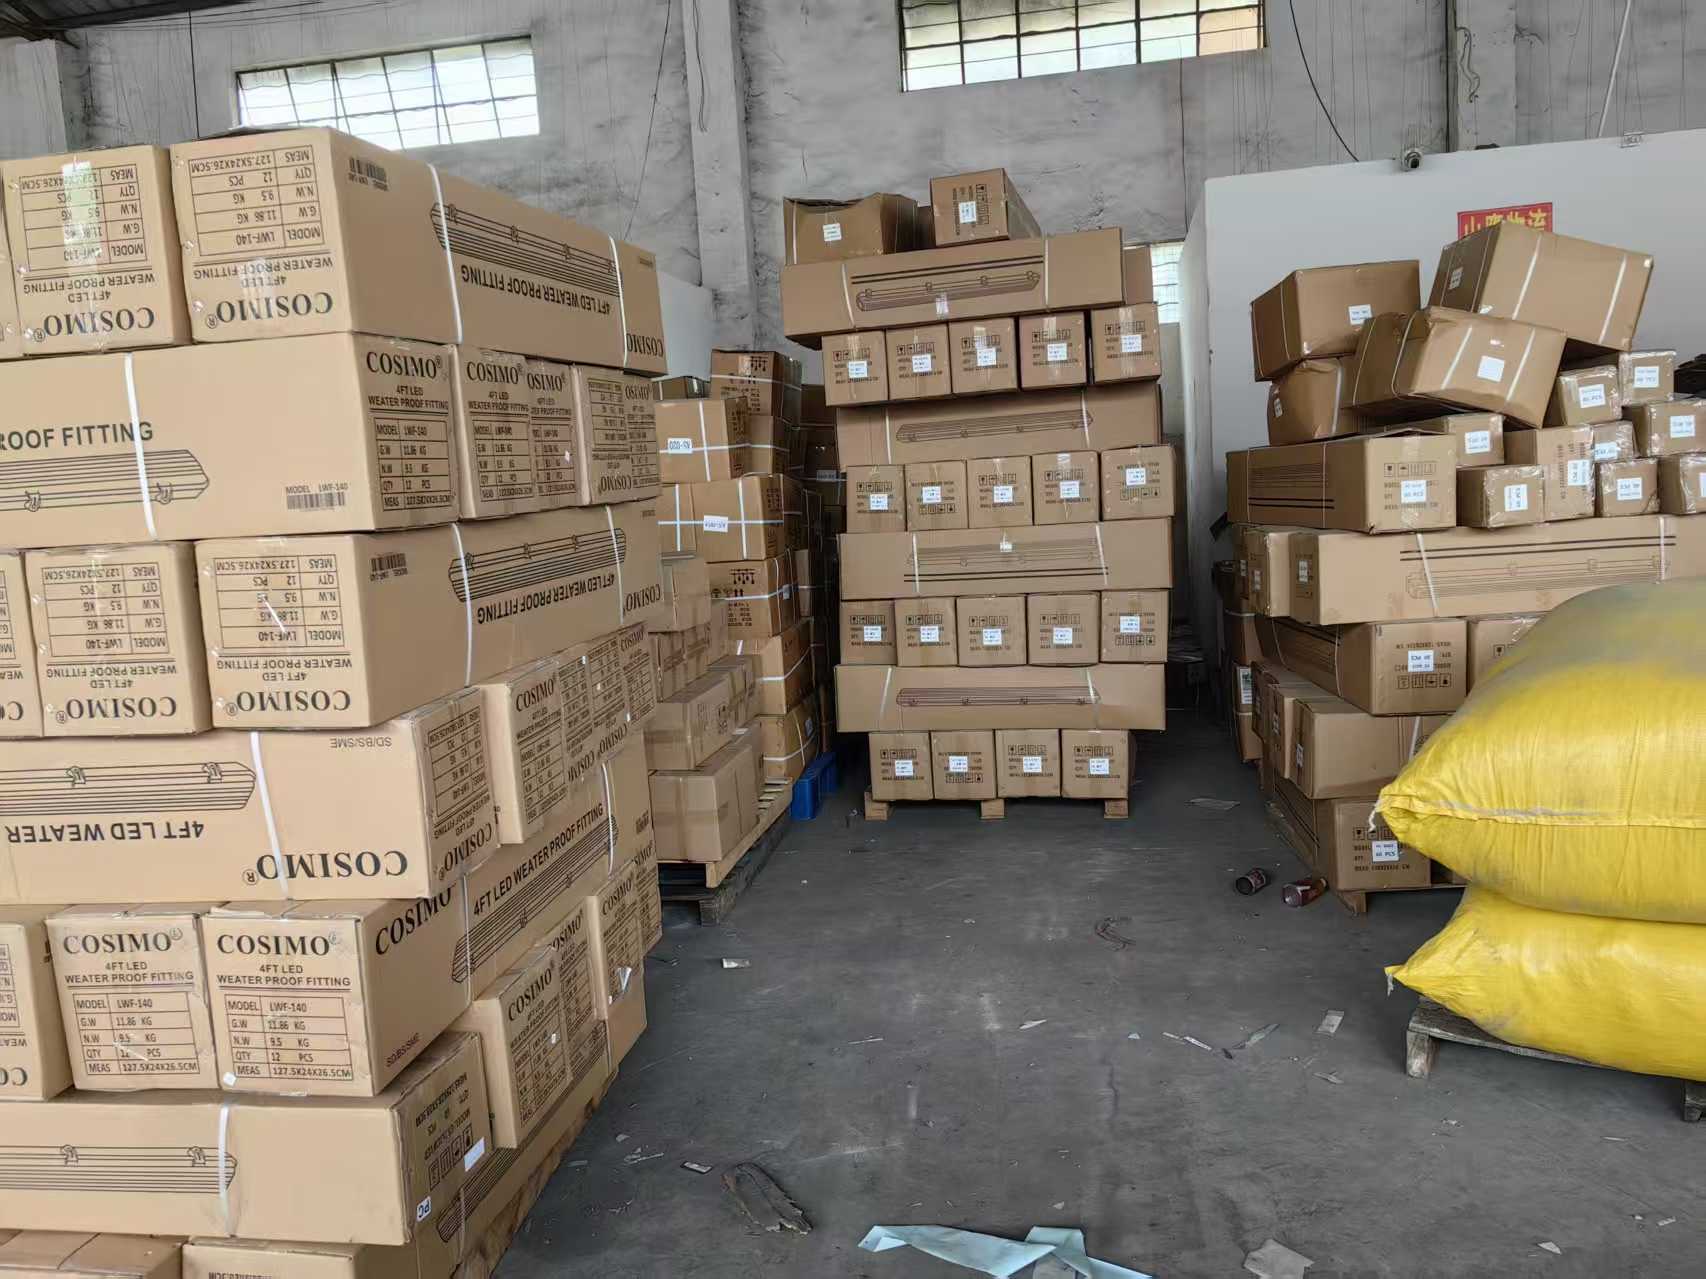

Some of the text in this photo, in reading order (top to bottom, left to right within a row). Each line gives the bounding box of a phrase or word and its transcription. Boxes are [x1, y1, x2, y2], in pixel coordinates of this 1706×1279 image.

[284, 148, 310, 161] MEAS
[109, 167, 133, 179] MEAS
[227, 166, 312, 186] QTY 12 PCS
[118, 184, 135, 196] QTY
[231, 193, 244, 204] KG
[235, 212, 249, 223] KG
[235, 226, 321, 245] MODEL LWF-140
[111, 242, 143, 256] MODEL
[282, 256, 333, 271] WEATER
[194, 265, 237, 279] FITTING
[460, 265, 506, 290] FITTING
[24, 272, 154, 293] WEATER PROOF FITTING
[266, 275, 287, 286] 4FT
[507, 278, 542, 298] PROOF
[68, 290, 111, 302] 4FT LED
[543, 285, 579, 306] WEATER
[580, 296, 597, 312] LED
[62, 421, 153, 446] FITTING
[308, 558, 333, 567] MEAS
[132, 566, 156, 575] MEAS
[252, 574, 335, 586] QTY 12 PCS
[78, 581, 158, 594] QTY 12 PCS
[553, 579, 587, 602] WEATER
[82, 601, 94, 610] KG
[520, 587, 552, 612] PROOF
[477, 597, 519, 624] FITTING
[86, 619, 98, 628] KG
[307, 629, 341, 640] MODEL
[84, 635, 165, 648] MODEL LWF-140
[216, 657, 351, 668] WEATER PROOF FITTING
[45, 663, 177, 677] WEATER PROOF FITTING
[262, 671, 306, 679] 4FT LED
[90, 678, 133, 688] 4FT LED
[7, 822, 205, 843] 4FT LED WEATER
[474, 803, 603, 915] 4FT LED WEATER PROOF FITTING
[105, 962, 148, 971] 4FT LED
[259, 965, 304, 974] 4FT LED
[64, 972, 193, 984] WEATER PROOF FITTING
[217, 975, 350, 987] WEATER PROOF FITTING
[74, 999, 153, 1010] MODEL LWF-140
[227, 1001, 308, 1012] MODEL LWF-140
[141, 1018, 153, 1026] KG
[294, 1021, 307, 1030] KG
[145, 1034, 157, 1042] KG
[298, 1038, 310, 1046] KG
[85, 1050, 102, 1059] QTY
[146, 1049, 162, 1058] PCS
[235, 1052, 314, 1062] QTY 12 PCS
[88, 1065, 111, 1073] MEAS
[237, 1067, 261, 1075] MEAS
